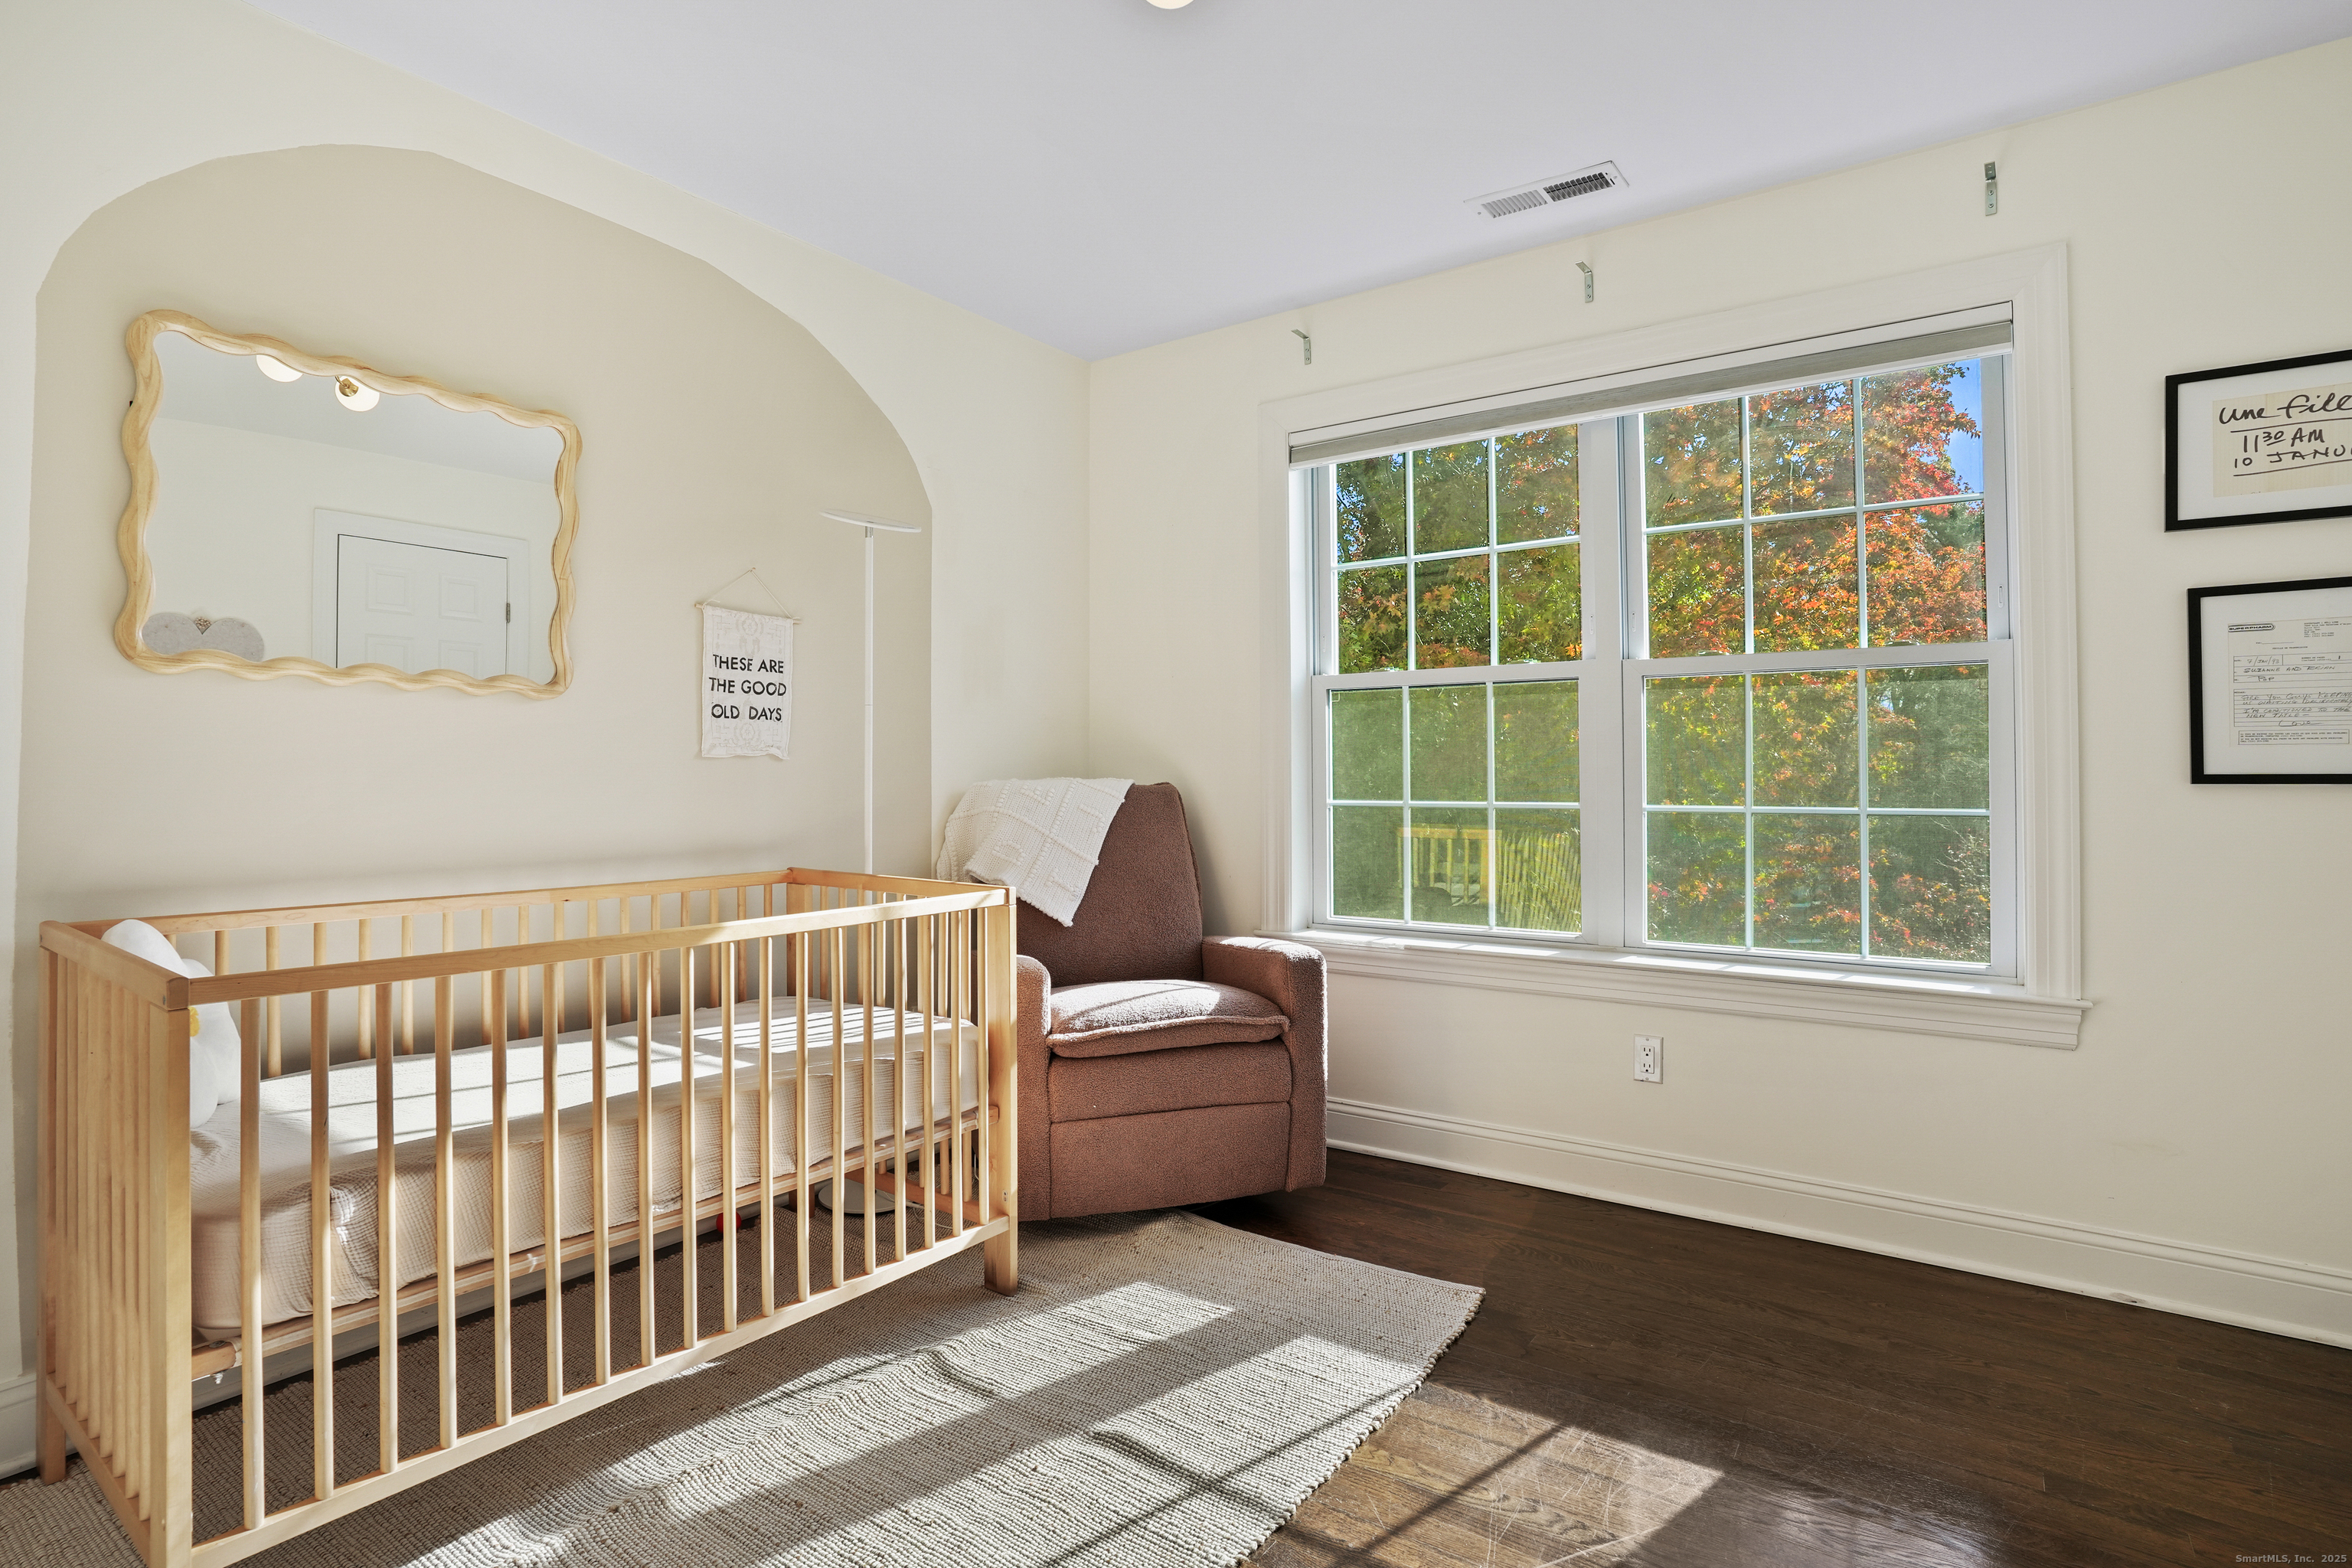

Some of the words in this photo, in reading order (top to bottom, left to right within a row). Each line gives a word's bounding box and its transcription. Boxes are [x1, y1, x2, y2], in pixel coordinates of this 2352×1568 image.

[2291, 427, 2325, 447] AM
[2234, 457, 2252, 469] 10
[2266, 445, 2352, 463] JANU
[713, 654, 753, 671] THESE
[757, 658, 784, 674] ARE
[708, 677, 735, 694] THE
[740, 679, 787, 696] GOOD
[711, 704, 740, 719] OLD
